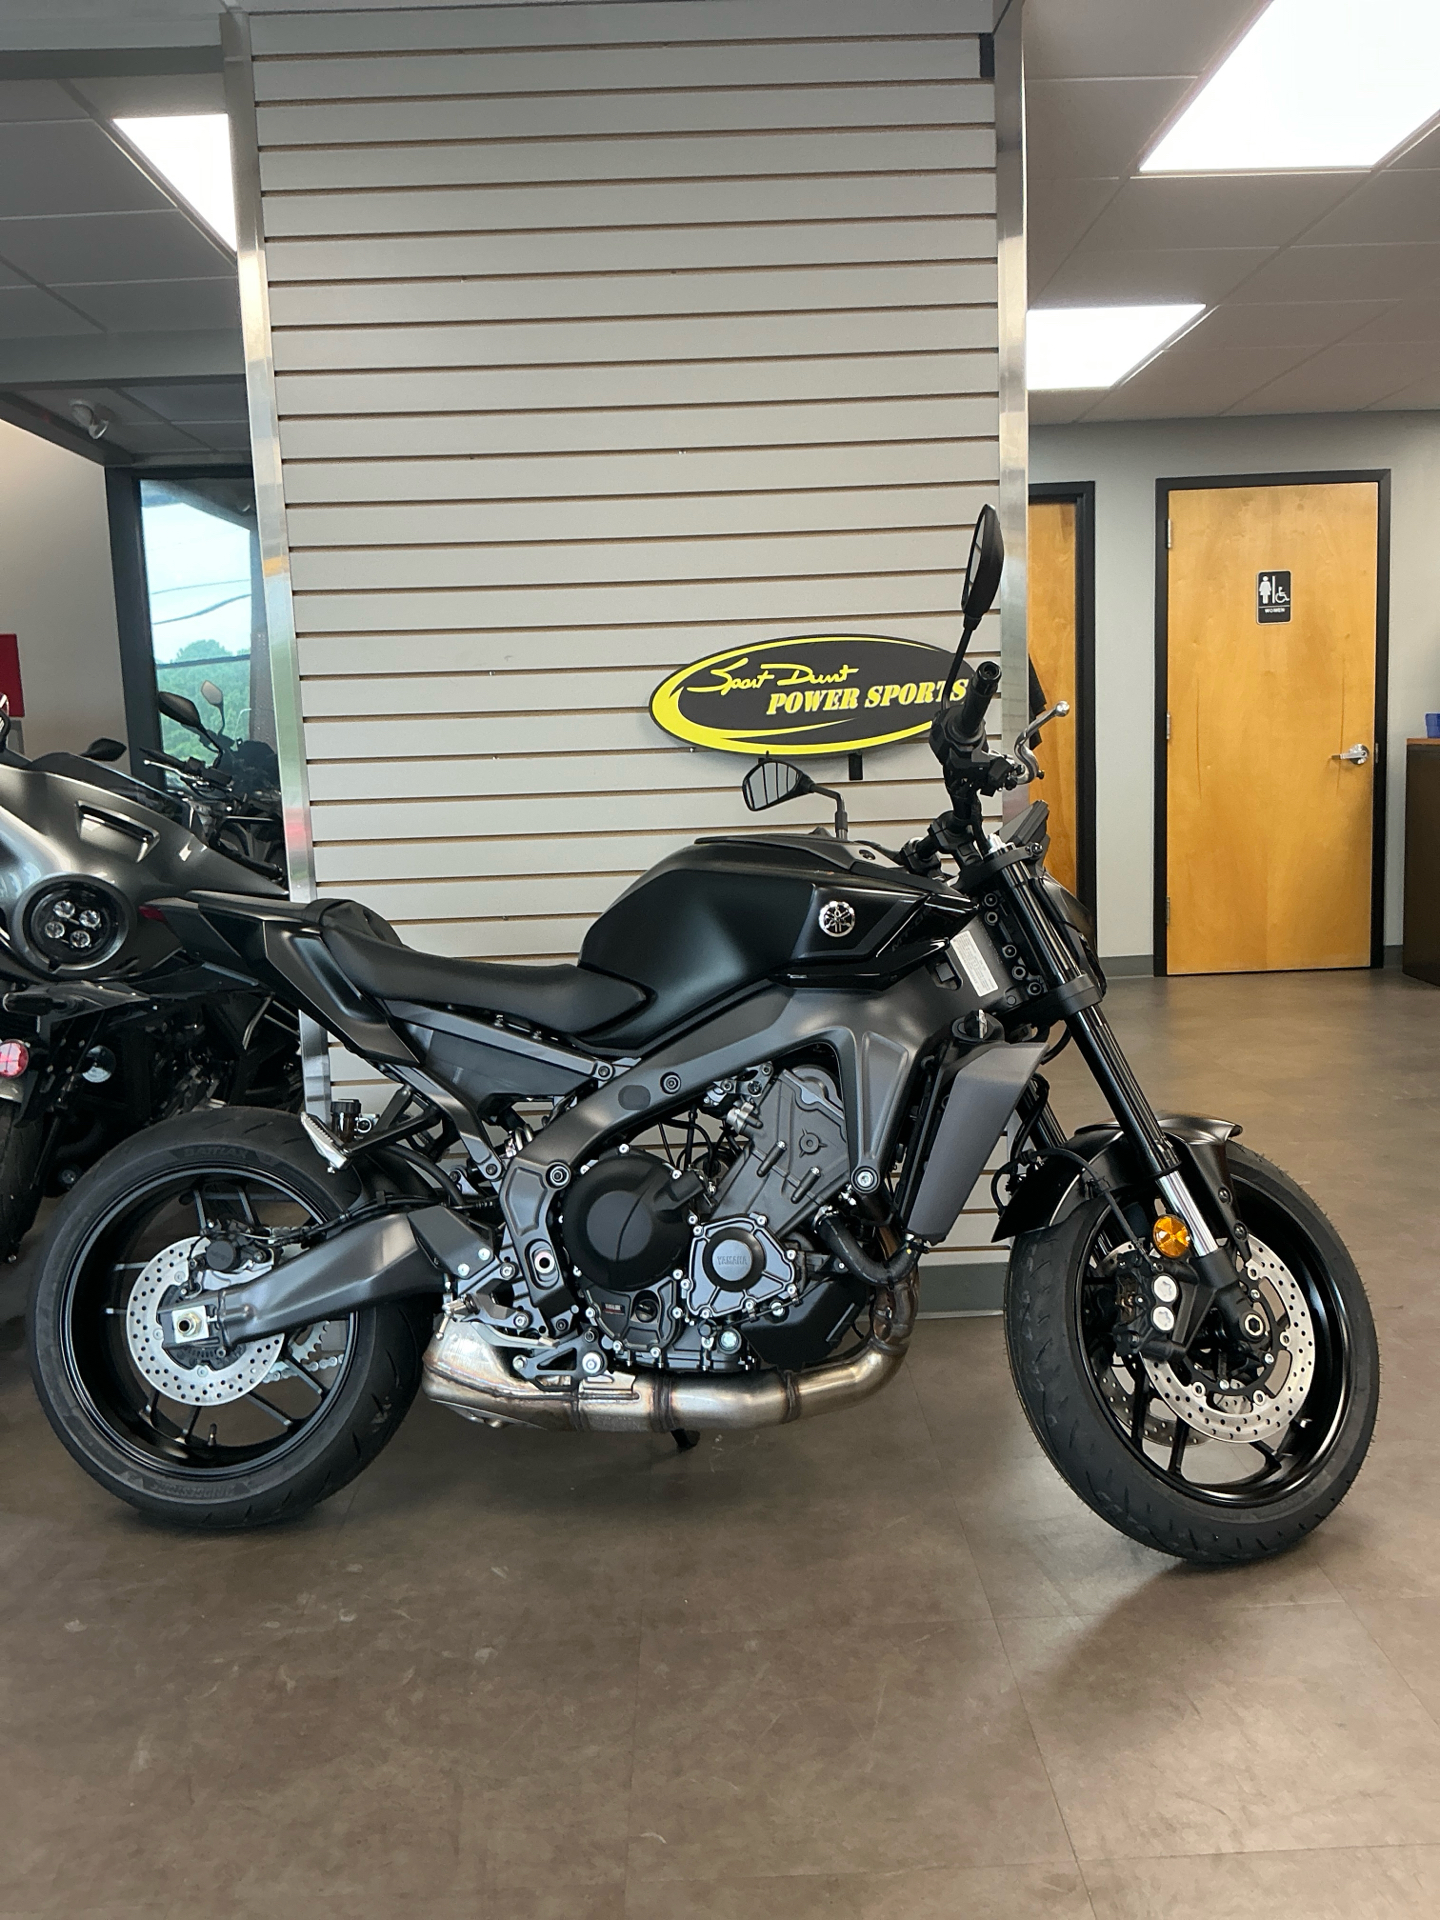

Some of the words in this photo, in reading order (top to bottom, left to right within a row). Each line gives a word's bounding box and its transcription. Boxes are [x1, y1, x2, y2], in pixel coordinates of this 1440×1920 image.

[766, 687, 860, 715] POWER
[864, 678, 969, 708] SPORTS
[717, 1255, 748, 1266] YAMAHA
